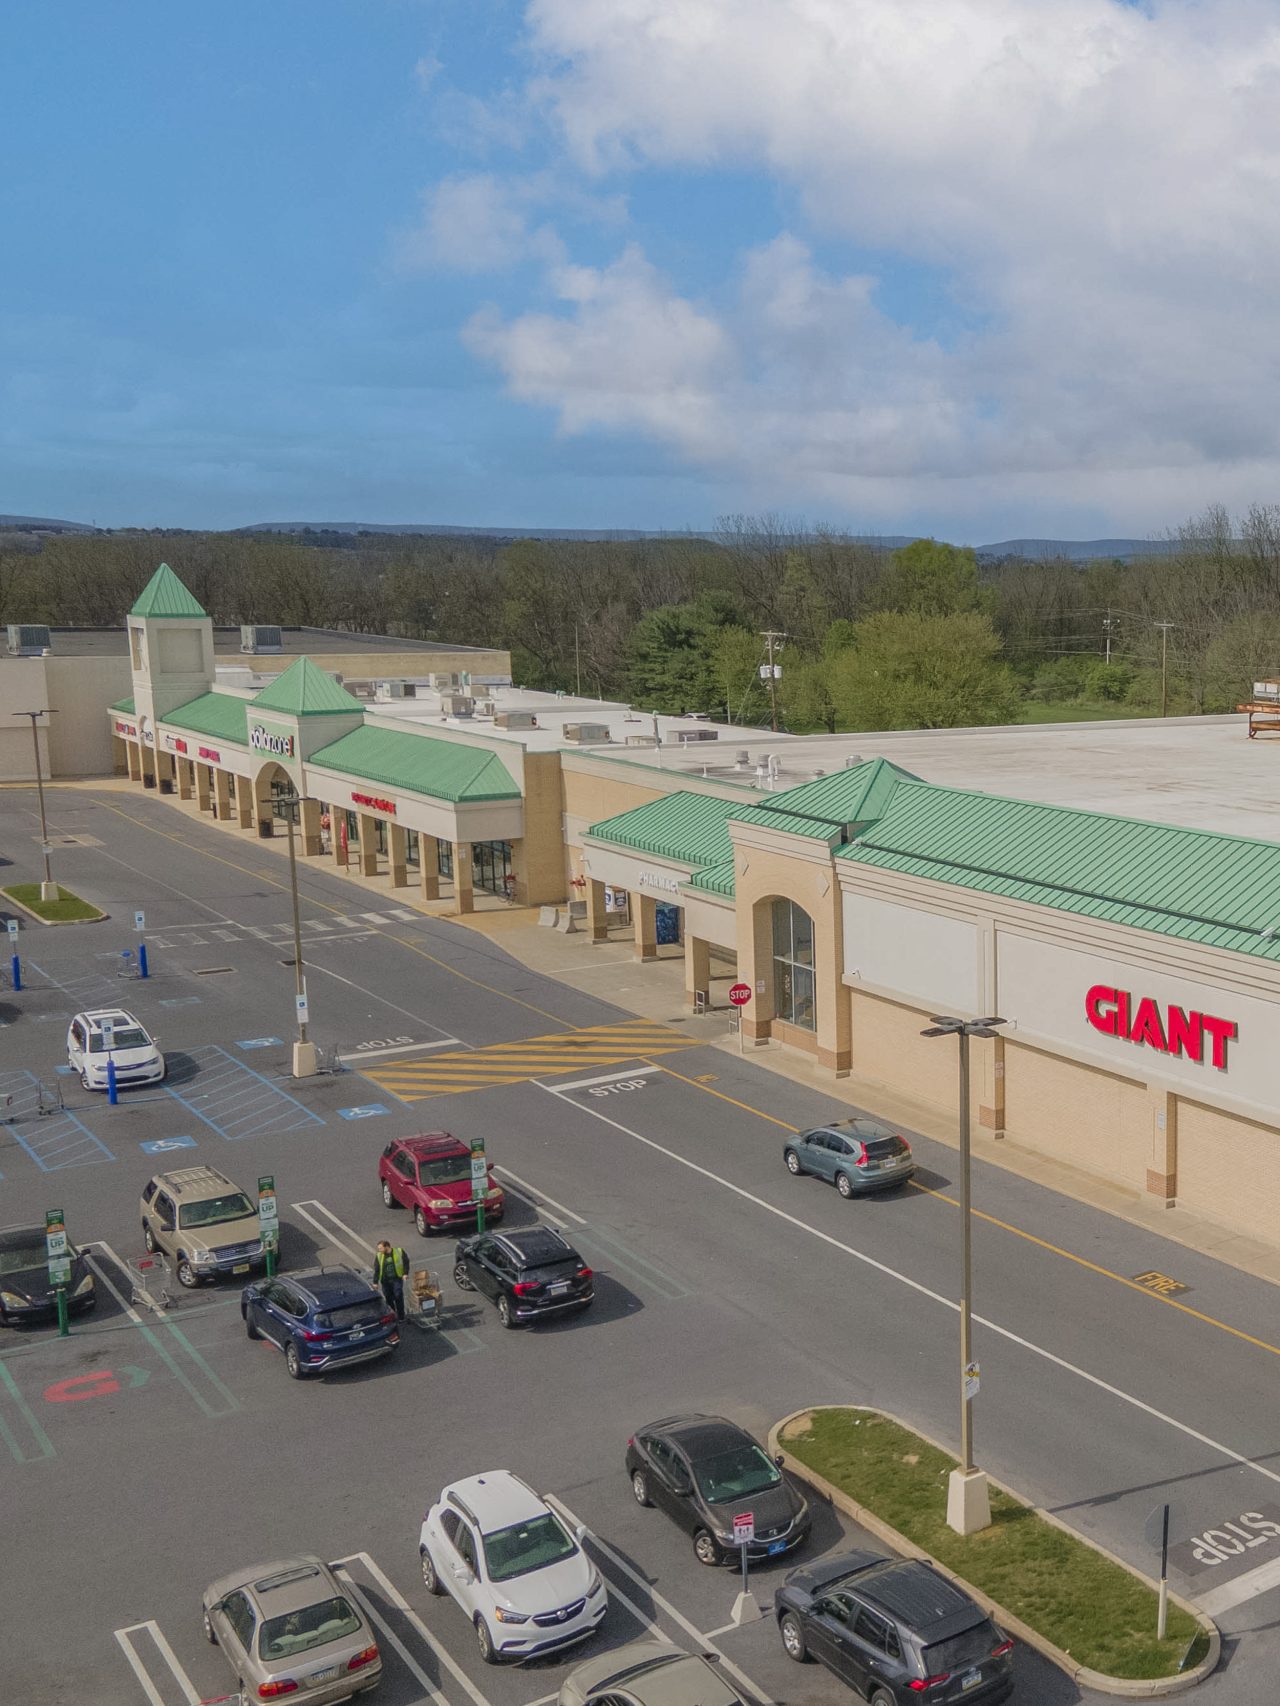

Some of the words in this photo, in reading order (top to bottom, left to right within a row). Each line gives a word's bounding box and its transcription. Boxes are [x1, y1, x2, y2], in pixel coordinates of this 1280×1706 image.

[730, 989, 751, 1000] STOP
[1085, 984, 1238, 1071] GIANT
[356, 1036, 414, 1050] STOP
[588, 1079, 647, 1097] STOP
[265, 1231, 273, 1241] 2
[50, 1240, 65, 1249] UP
[55, 1271, 64, 1283] 3
[1134, 1272, 1186, 1295] FIRE
